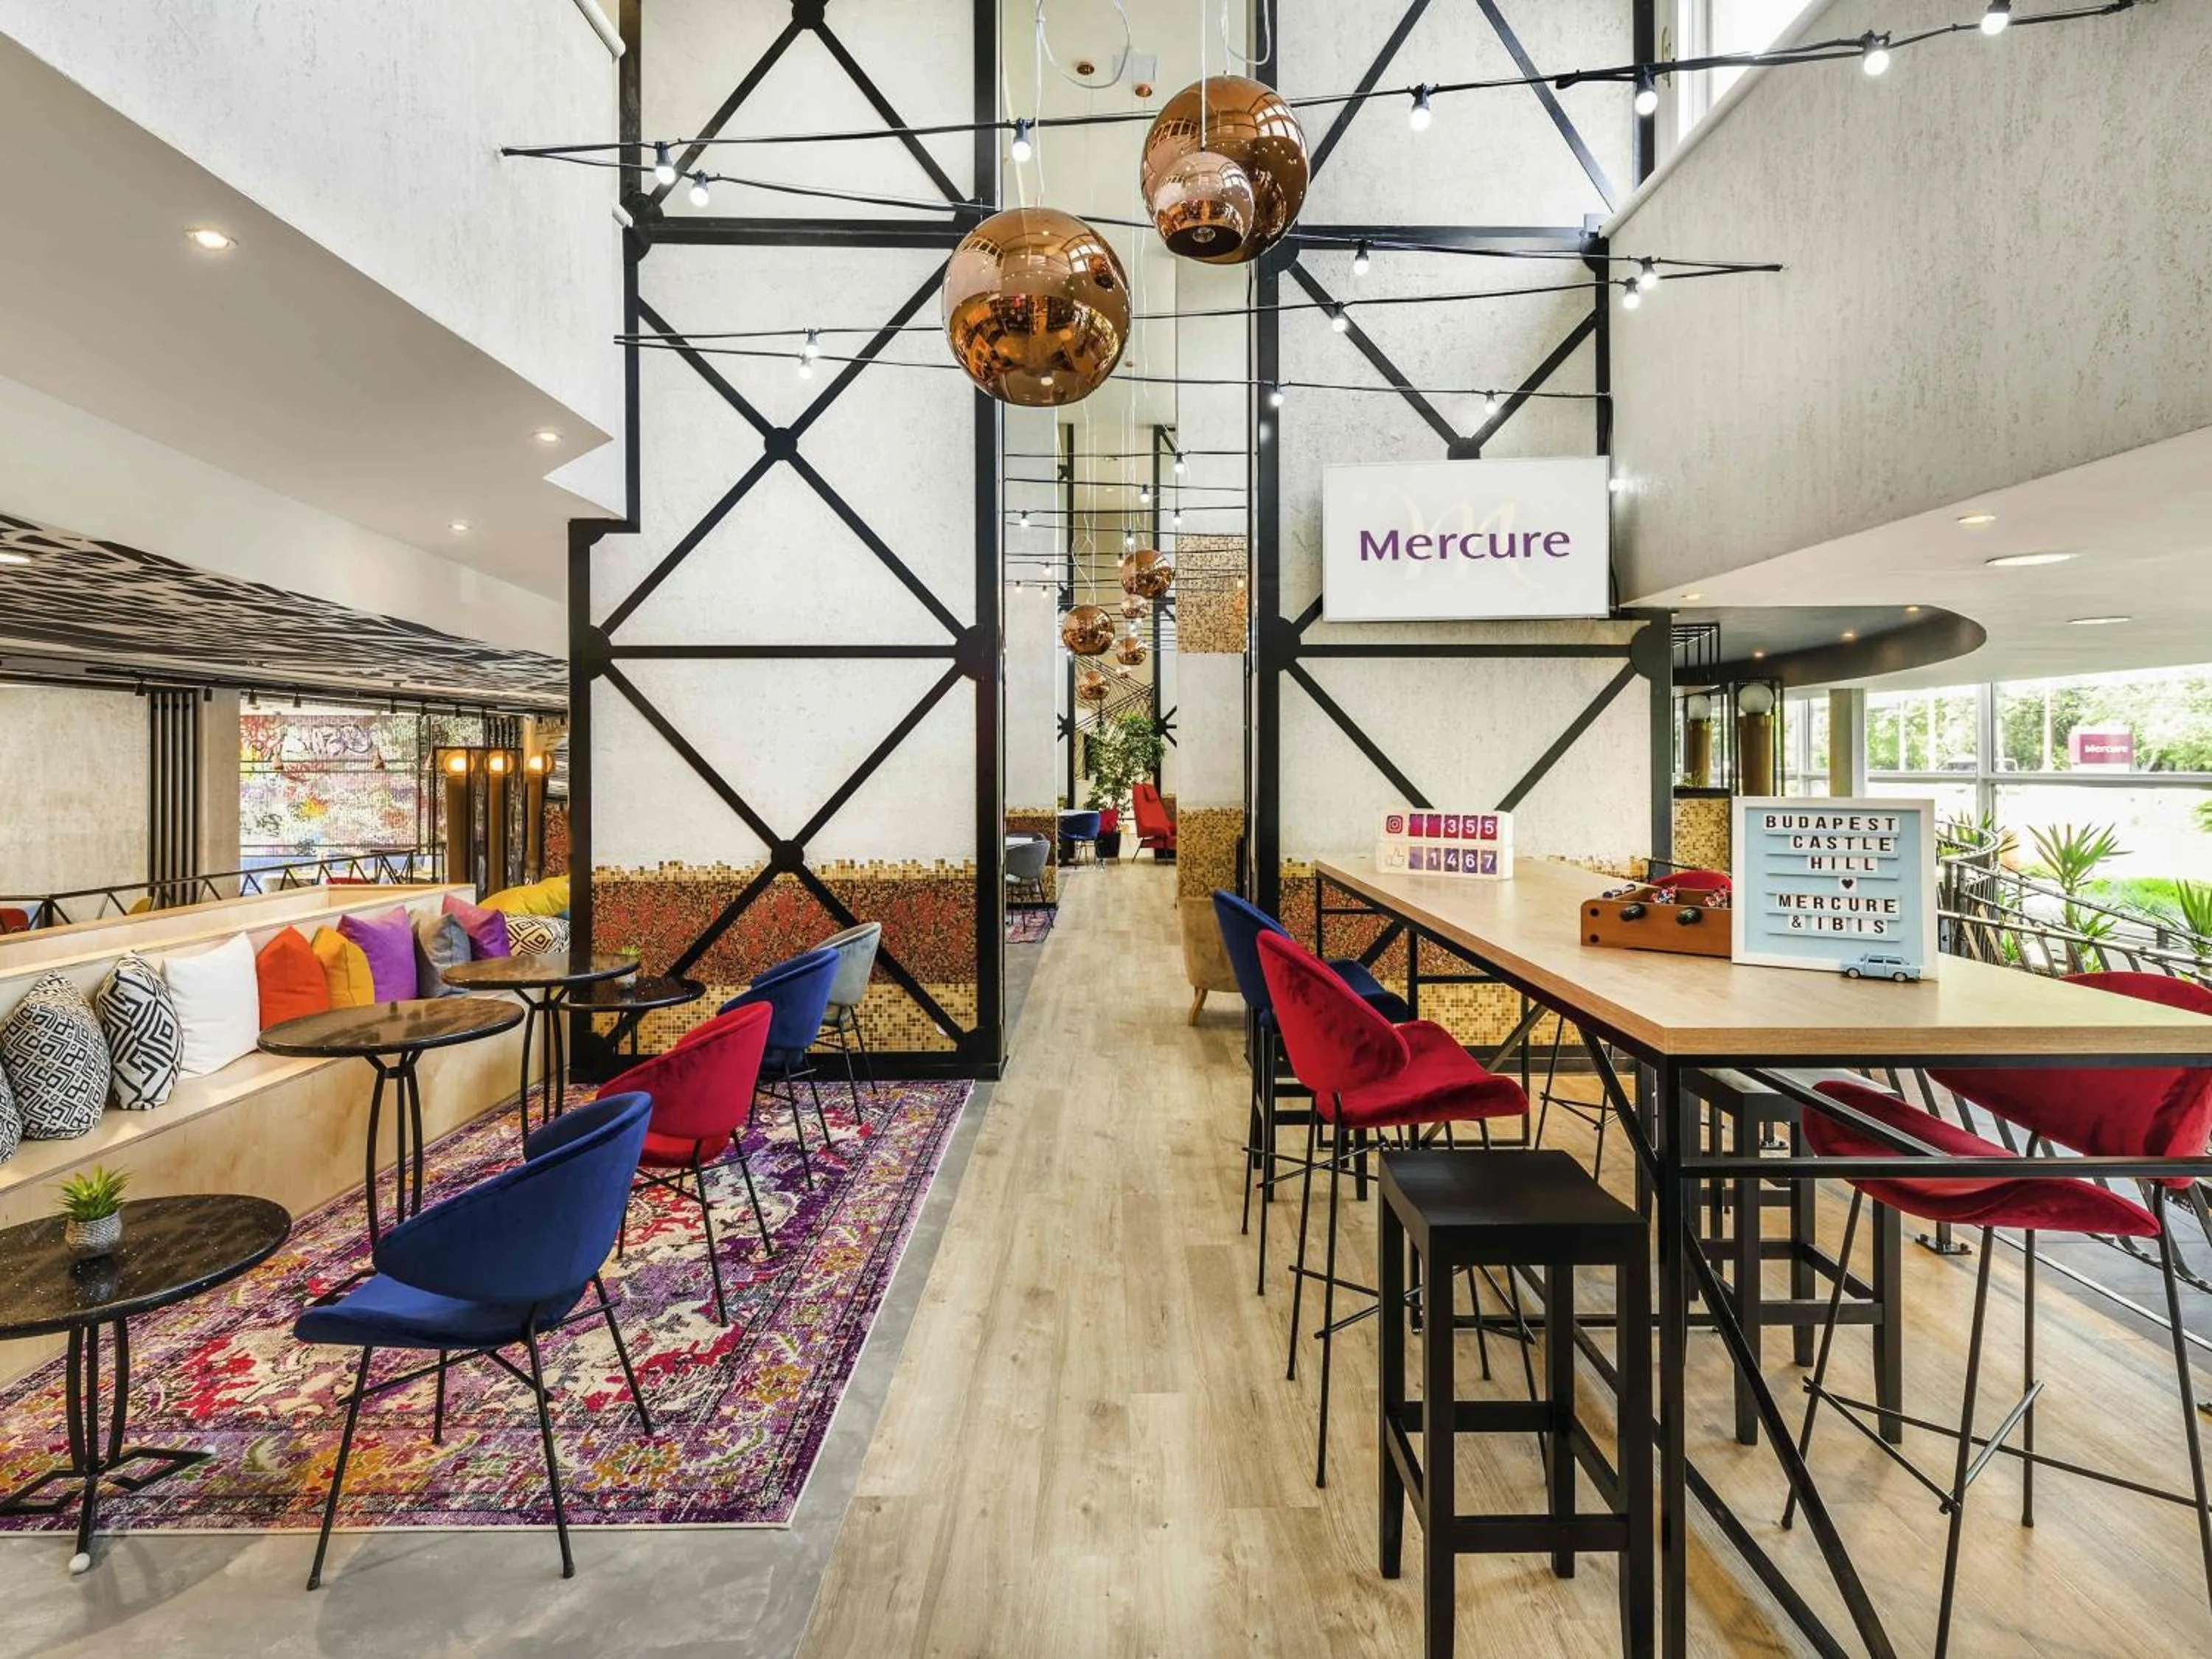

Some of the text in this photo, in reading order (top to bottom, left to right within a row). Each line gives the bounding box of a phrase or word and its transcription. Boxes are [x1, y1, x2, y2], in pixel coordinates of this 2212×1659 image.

[1360, 529, 1571, 561] Mercure
[1766, 815, 1896, 830] BUDAPEST
[1793, 835, 1891, 851] CASTLE
[1430, 853, 1494, 869] 1467
[1810, 857, 1874, 871] HILL
[1778, 894, 1896, 913] MERCURE
[1792, 916, 1885, 933] & IBIS
